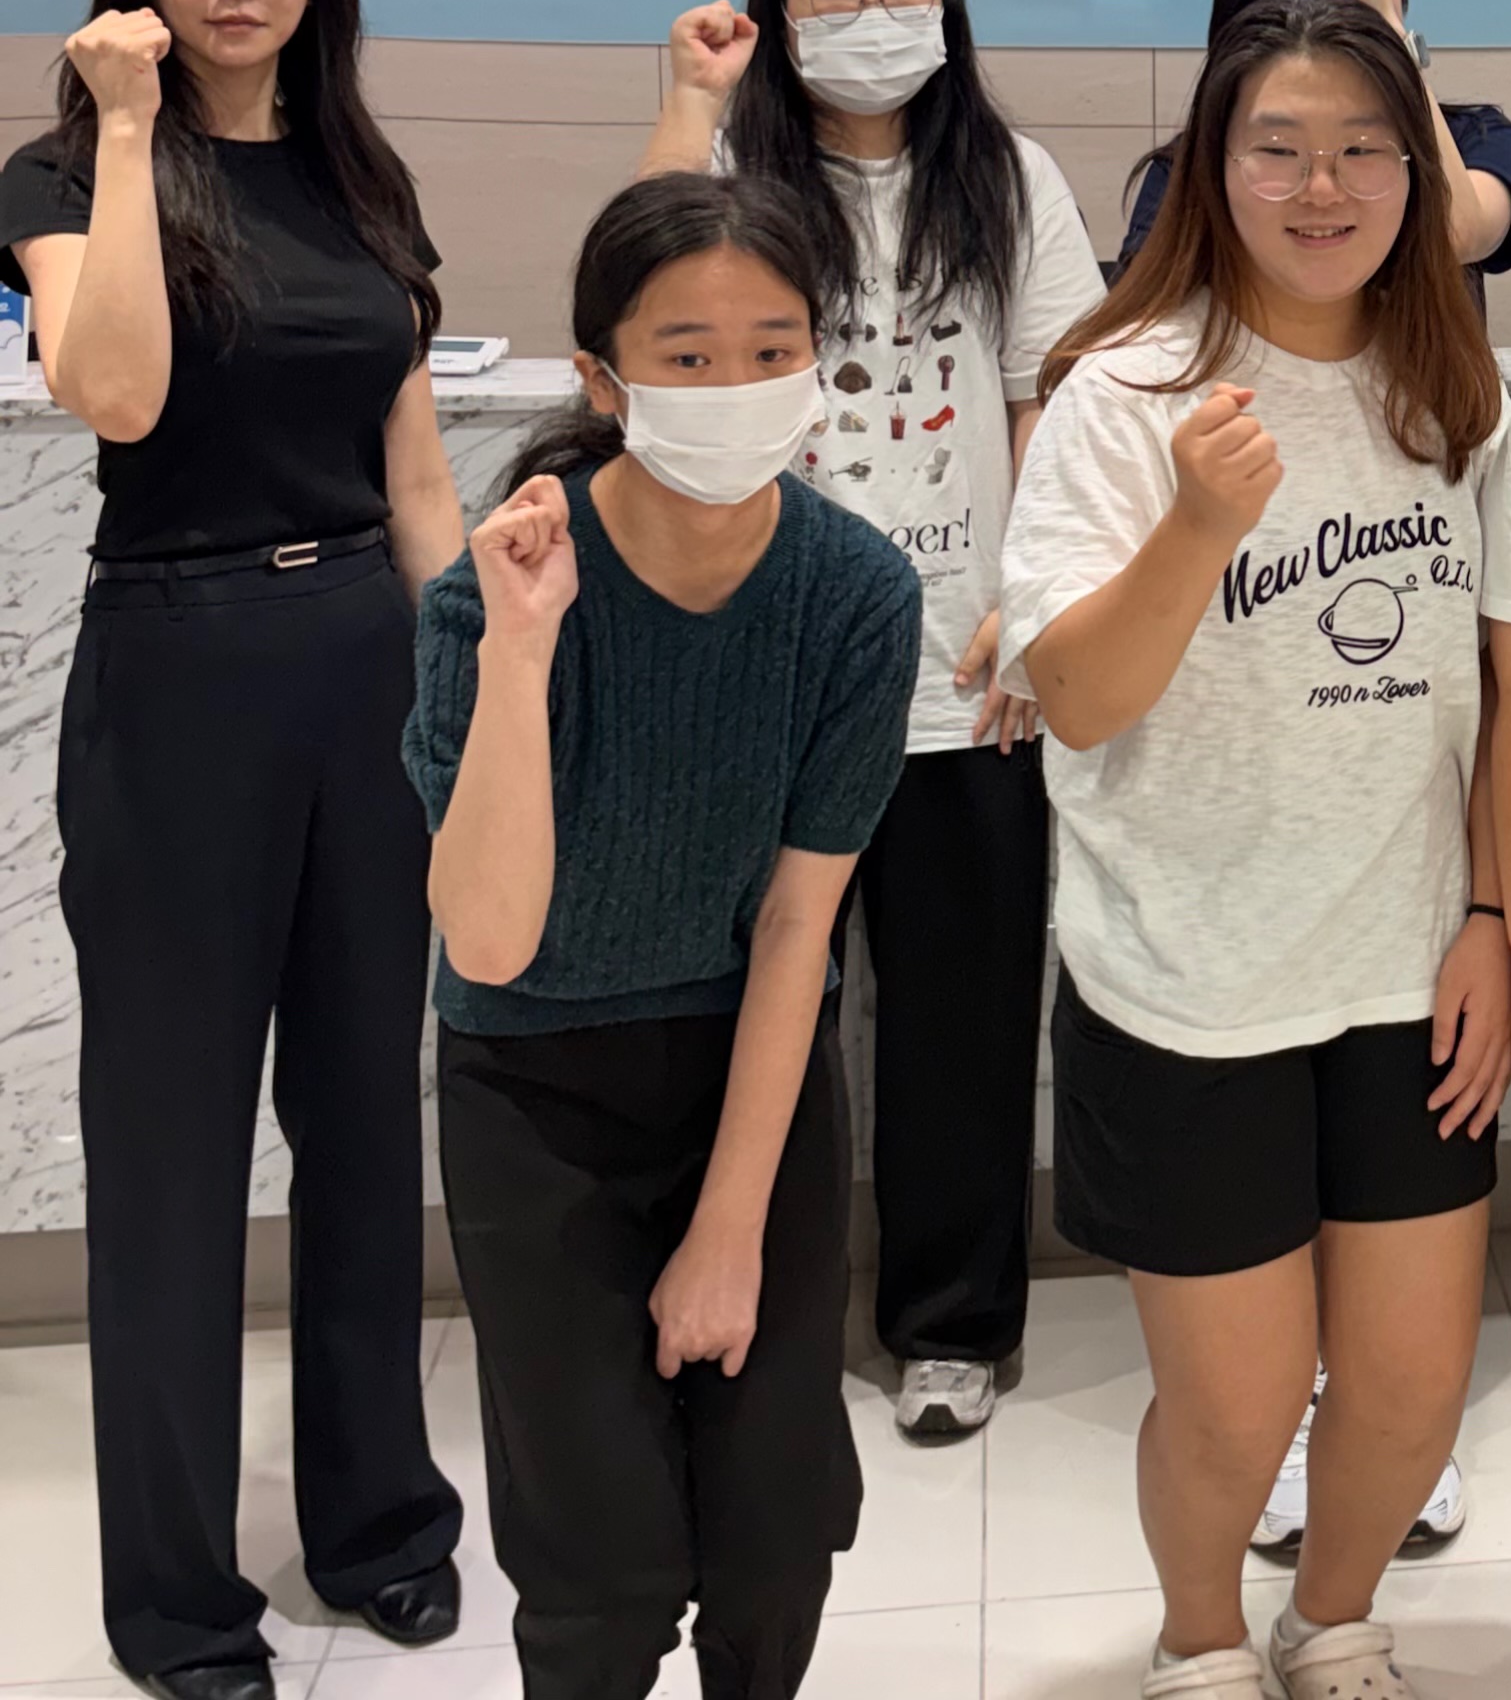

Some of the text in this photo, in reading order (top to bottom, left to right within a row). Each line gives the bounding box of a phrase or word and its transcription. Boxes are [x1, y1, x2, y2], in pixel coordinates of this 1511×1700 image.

[1223, 502, 1452, 624] New Classic
[1307, 684, 1352, 708] 1990
